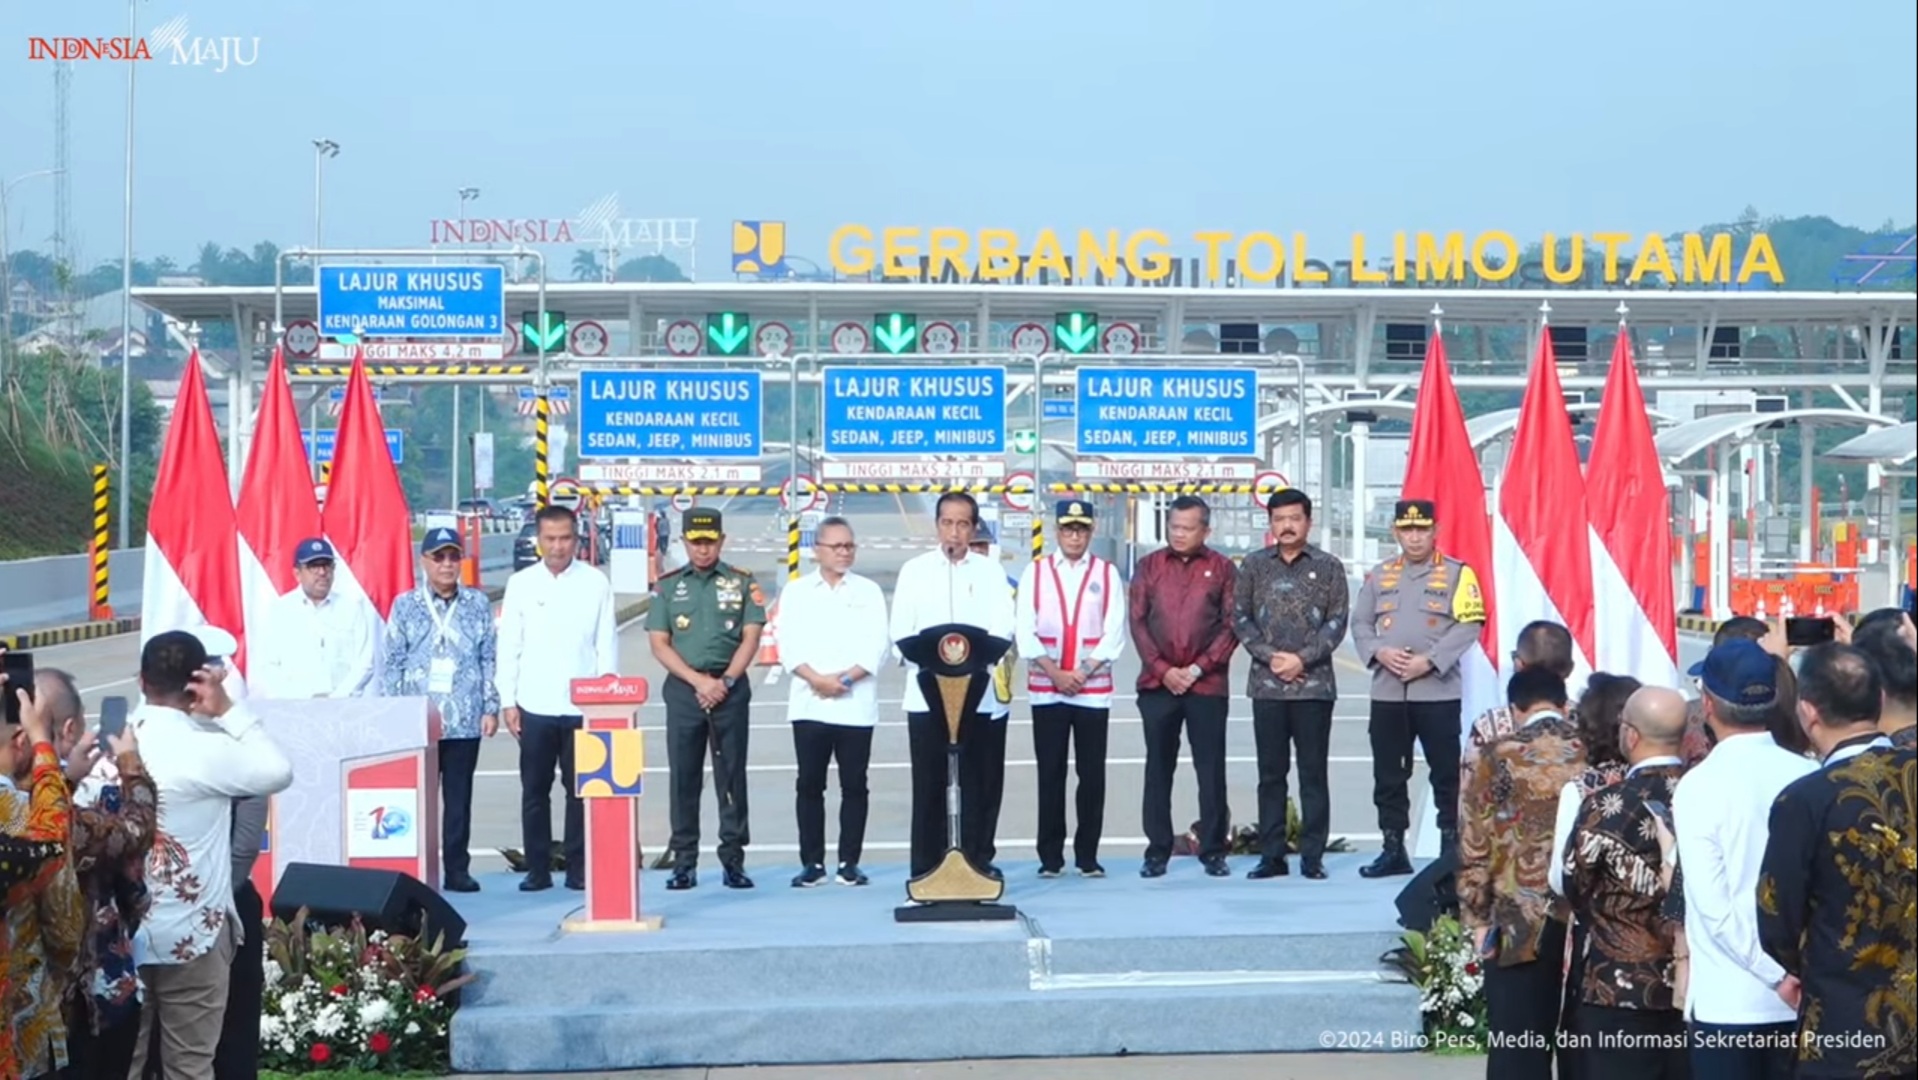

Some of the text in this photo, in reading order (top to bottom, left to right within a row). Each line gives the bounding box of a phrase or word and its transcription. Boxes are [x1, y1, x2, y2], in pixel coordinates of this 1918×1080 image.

[430, 217, 699, 255] INDONESIA MAJU
[828, 223, 1173, 281] GERBANG
[1193, 230, 1329, 283] TOL
[1351, 230, 1520, 282] LIMO
[1542, 231, 1786, 284] UTAMA
[338, 272, 484, 291] LAJUR KHUSUS
[377, 295, 445, 310] MAKSIMAL
[325, 314, 499, 329] KENDARAAN GOLONGAN 3
[342, 344, 482, 359] TIGGI MAKS 4.2 m
[591, 380, 656, 400] LAJUR
[666, 380, 750, 401] KHUSUS
[834, 376, 994, 398] LAJUR KHUSUS
[1088, 377, 1246, 399] LAJUR KHUSUS
[605, 412, 741, 427] KENDARAAN KECIL
[846, 405, 982, 421] KENDARAAN KECIL
[1099, 405, 1233, 422] KENDARAAN KECIL
[588, 432, 752, 450] SEDAN, JEEP, MINIBUS
[831, 429, 996, 446] SEDAN, JEEP, MINIBUS
[1084, 429, 1248, 447] SEDAN, JEEP, MINIBUS
[601, 466, 740, 480] TINGGI MAKS 2.1 m
[845, 464, 983, 477] TINGGI MAKS 2.1 m
[1097, 463, 1234, 477] TINGGI MAKS 2.1 m
